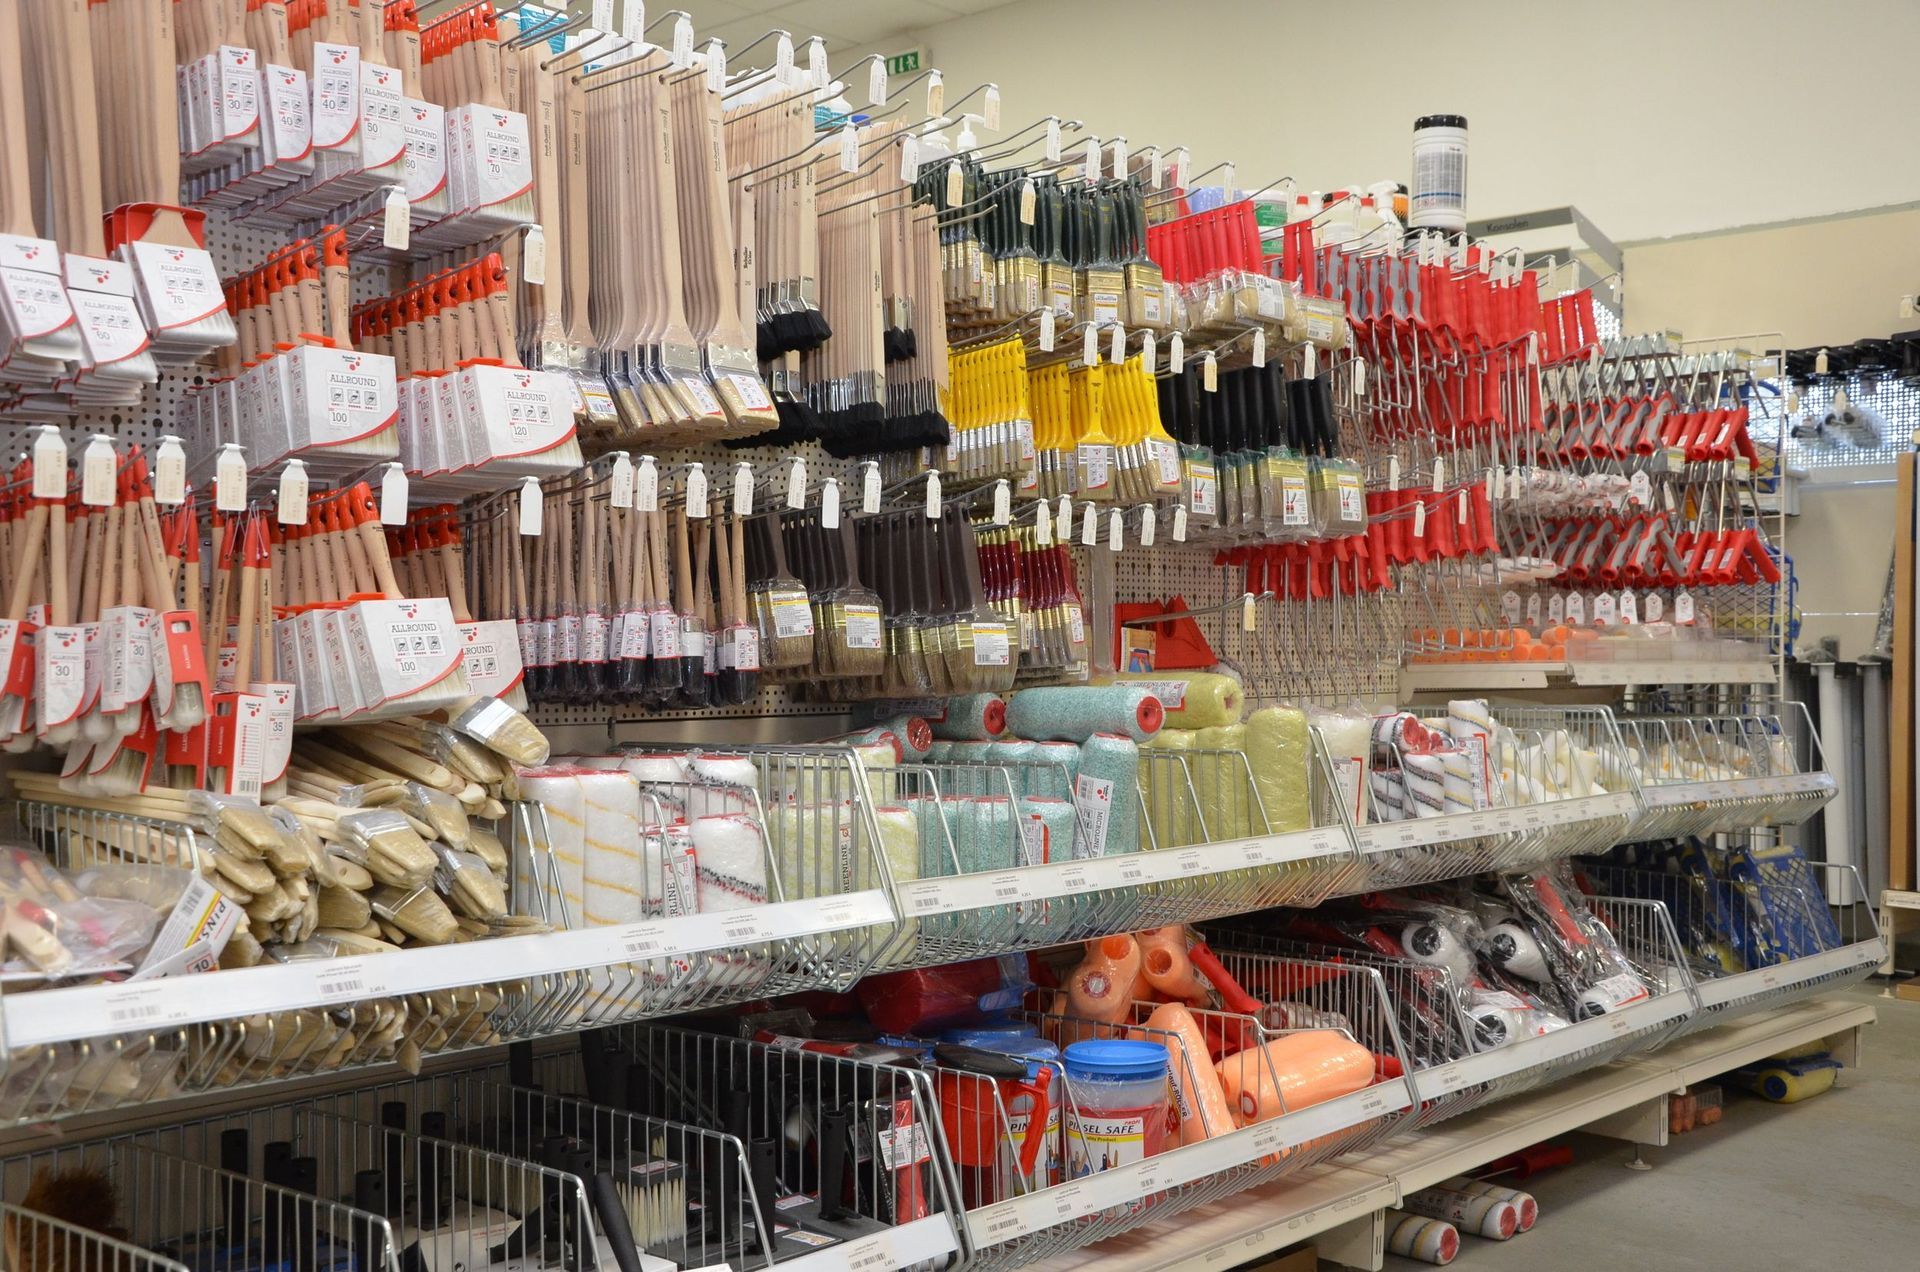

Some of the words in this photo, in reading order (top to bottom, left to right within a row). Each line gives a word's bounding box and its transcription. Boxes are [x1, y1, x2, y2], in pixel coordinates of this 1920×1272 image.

[363, 87, 400, 101] ALLROUND
[228, 99, 240, 110] 30
[321, 99, 336, 110] 40
[280, 116, 293, 126] 40
[486, 131, 520, 144] ALLROUND
[490, 163, 501, 174] 70
[1487, 217, 1528, 233] Konsolen
[160, 264, 203, 275] ALLROUND
[170, 294, 184, 305] 75
[83, 301, 129, 313] ALLROUND
[330, 374, 377, 387] ALLROUND
[506, 391, 547, 402] ALLROUND
[331, 411, 348, 423] 100
[513, 426, 527, 437] 120
[391, 623, 437, 634] ALLROUND
[132, 645, 145, 657] 30
[463, 645, 494, 656] ROUND
[55, 665, 70, 677] 30
[401, 661, 416, 672] 100
[271, 721, 283, 732] 35
[667, 882, 678, 916] RLINE
[196, 900, 227, 941] PINS
[1105, 1124, 1135, 1134] SAFE
